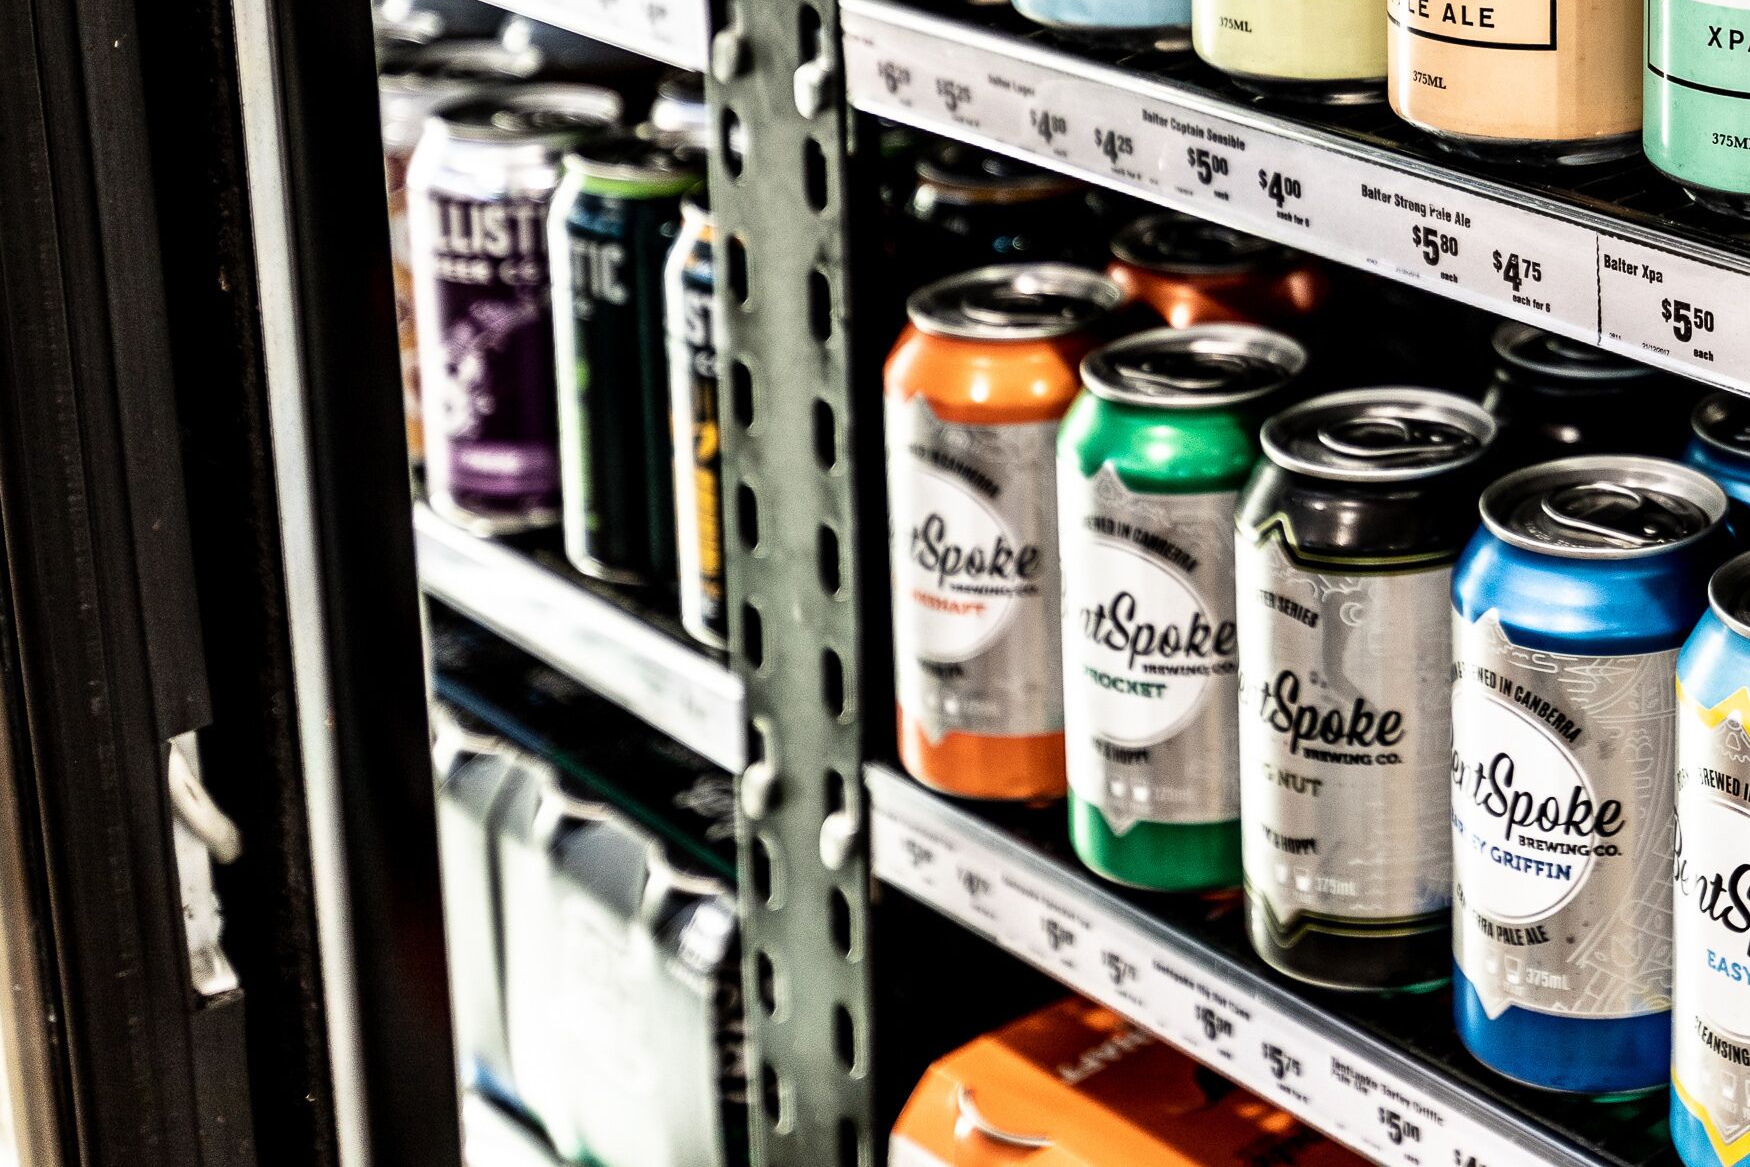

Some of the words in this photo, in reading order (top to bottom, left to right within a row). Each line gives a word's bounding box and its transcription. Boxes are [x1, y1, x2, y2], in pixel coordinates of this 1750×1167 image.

[1219, 15, 1253, 34] 375ML
[1440, 0, 1496, 30] ALE
[1412, 69, 1447, 91] 375ML
[1142, 109, 1169, 130] Balter
[1170, 116, 1205, 141] Captain
[1206, 127, 1246, 152] Sensible
[1187, 145, 1229, 185] $500
[1258, 167, 1302, 209] $400
[1361, 183, 1392, 205] Balter
[1394, 193, 1427, 219] Strong
[1429, 203, 1452, 223] Pale
[1454, 211, 1472, 229] Ale
[1411, 224, 1459, 266] $580
[1492, 249, 1542, 293] $475
[1603, 253, 1639, 276] Balter
[1641, 264, 1664, 285] Xpa
[1440, 271, 1459, 284] each
[1512, 293, 1531, 307] each
[1532, 298, 1544, 311] for
[1661, 297, 1715, 344] $550
[1693, 347, 1714, 362] each
[911, 512, 1041, 588] tSpoke
[1116, 520, 1130, 540] IN
[1132, 523, 1199, 575] CANBERRA
[1080, 590, 1238, 672] ntSpoke
[1276, 594, 1320, 630] SERIES
[1258, 668, 1406, 756] tSpoke
[1498, 675, 1514, 697] IN
[1513, 680, 1583, 744] CANBERRA
[1303, 746, 1373, 767] BREWING
[1374, 752, 1404, 767] CO.
[1276, 772, 1324, 797] NUT
[1450, 751, 1627, 842] entSpoke
[1697, 765, 1741, 800] BREWED
[1279, 834, 1318, 856] HOPPY
[1489, 844, 1573, 882] GRIFFIN
[1517, 833, 1591, 858] BREWING
[1594, 843, 1624, 858] CO.
[1495, 924, 1525, 947] PALE
[1525, 925, 1550, 947] ALE
